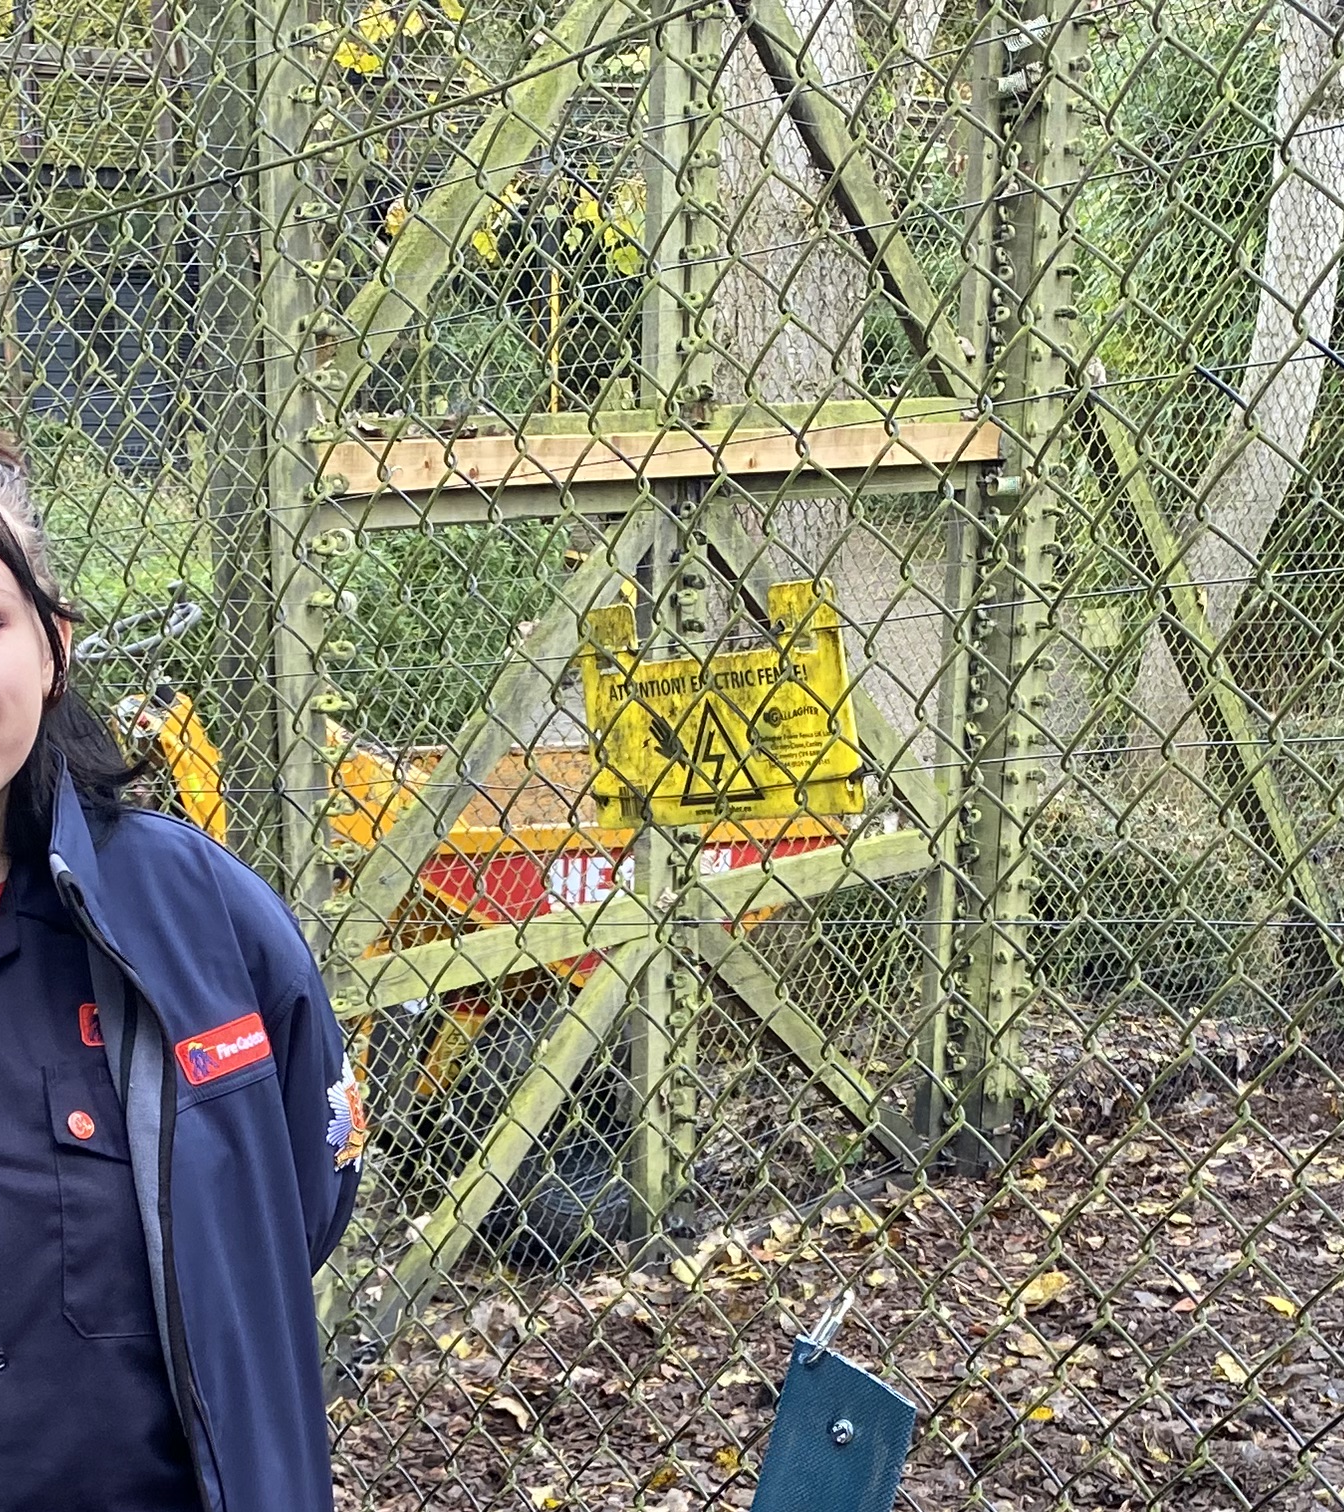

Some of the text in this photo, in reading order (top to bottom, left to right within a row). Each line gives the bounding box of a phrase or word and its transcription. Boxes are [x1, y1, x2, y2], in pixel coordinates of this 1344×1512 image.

[609, 663, 808, 702] ATNTION! ECTRIC FENE!
[216, 1031, 265, 1060] Fire Cadets
